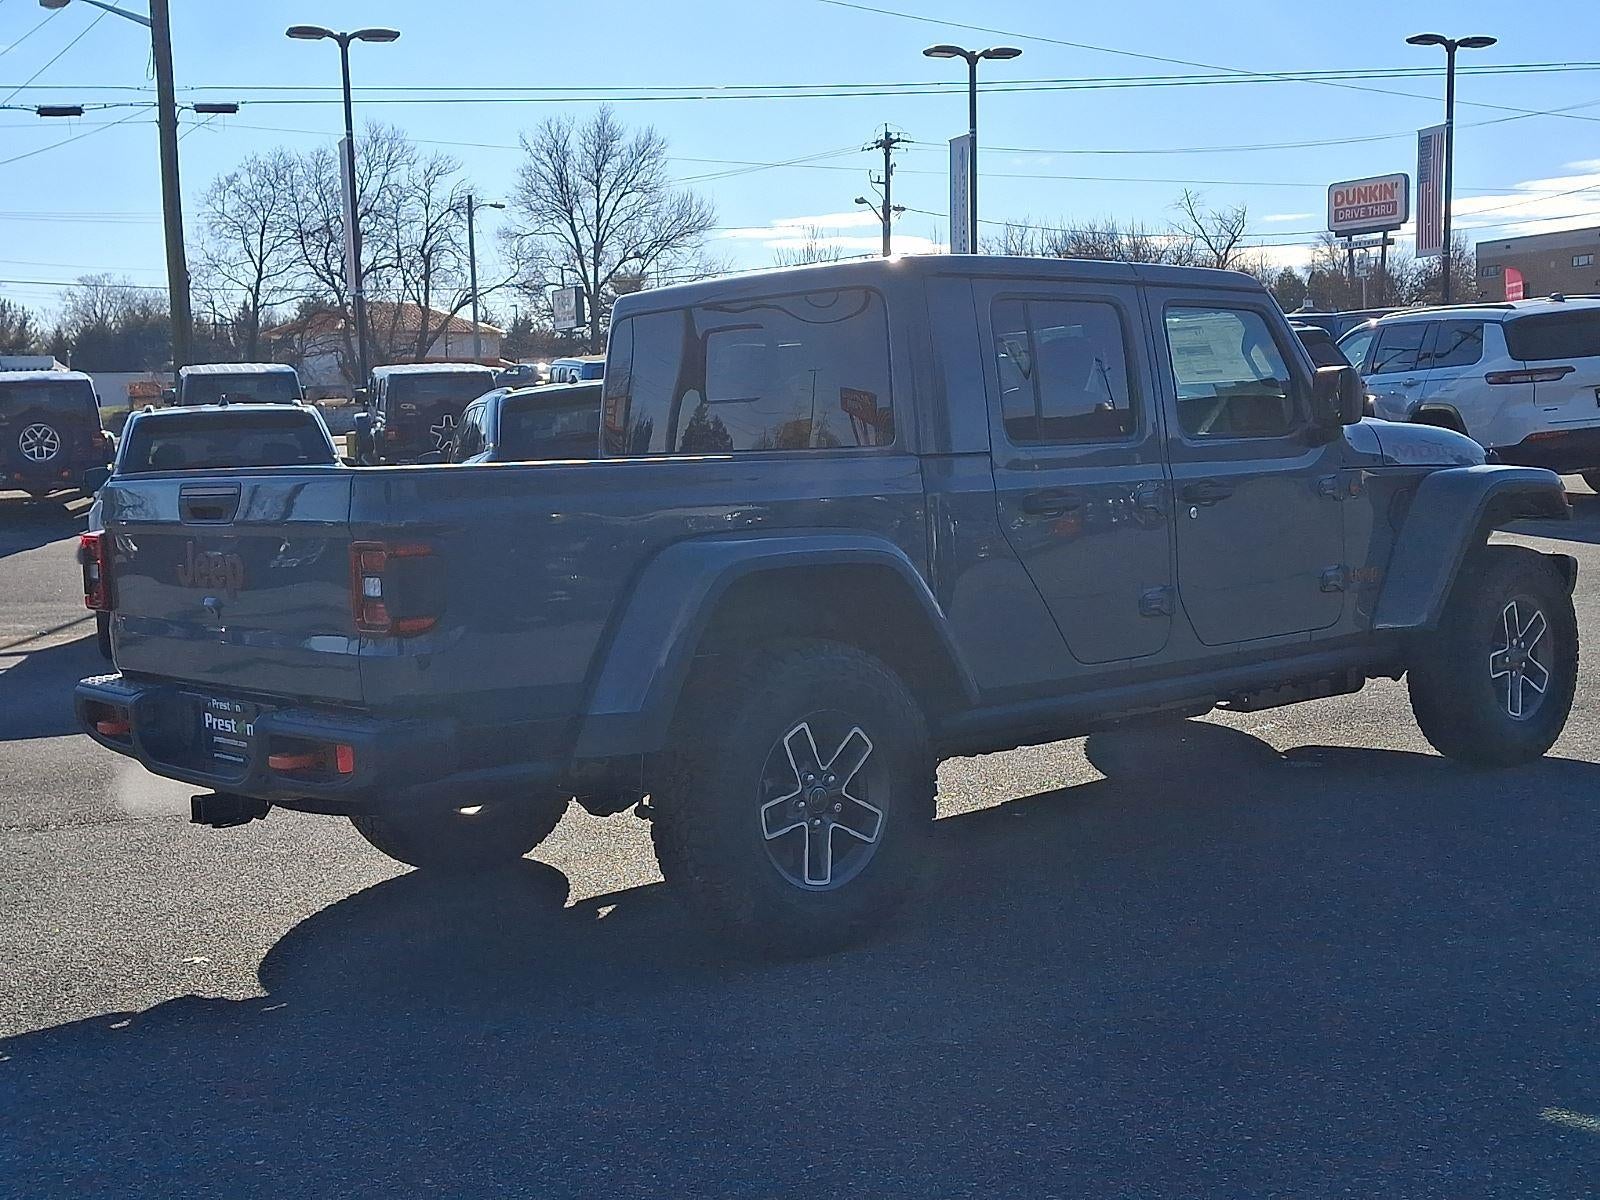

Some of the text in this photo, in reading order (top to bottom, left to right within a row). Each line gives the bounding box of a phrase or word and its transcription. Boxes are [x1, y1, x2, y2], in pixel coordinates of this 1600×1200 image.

[1334, 182, 1398, 207] DUNKIN'
[1338, 203, 1393, 220] DRIVE THRU
[178, 541, 243, 597] Jeep
[211, 698, 241, 712] Prestn
